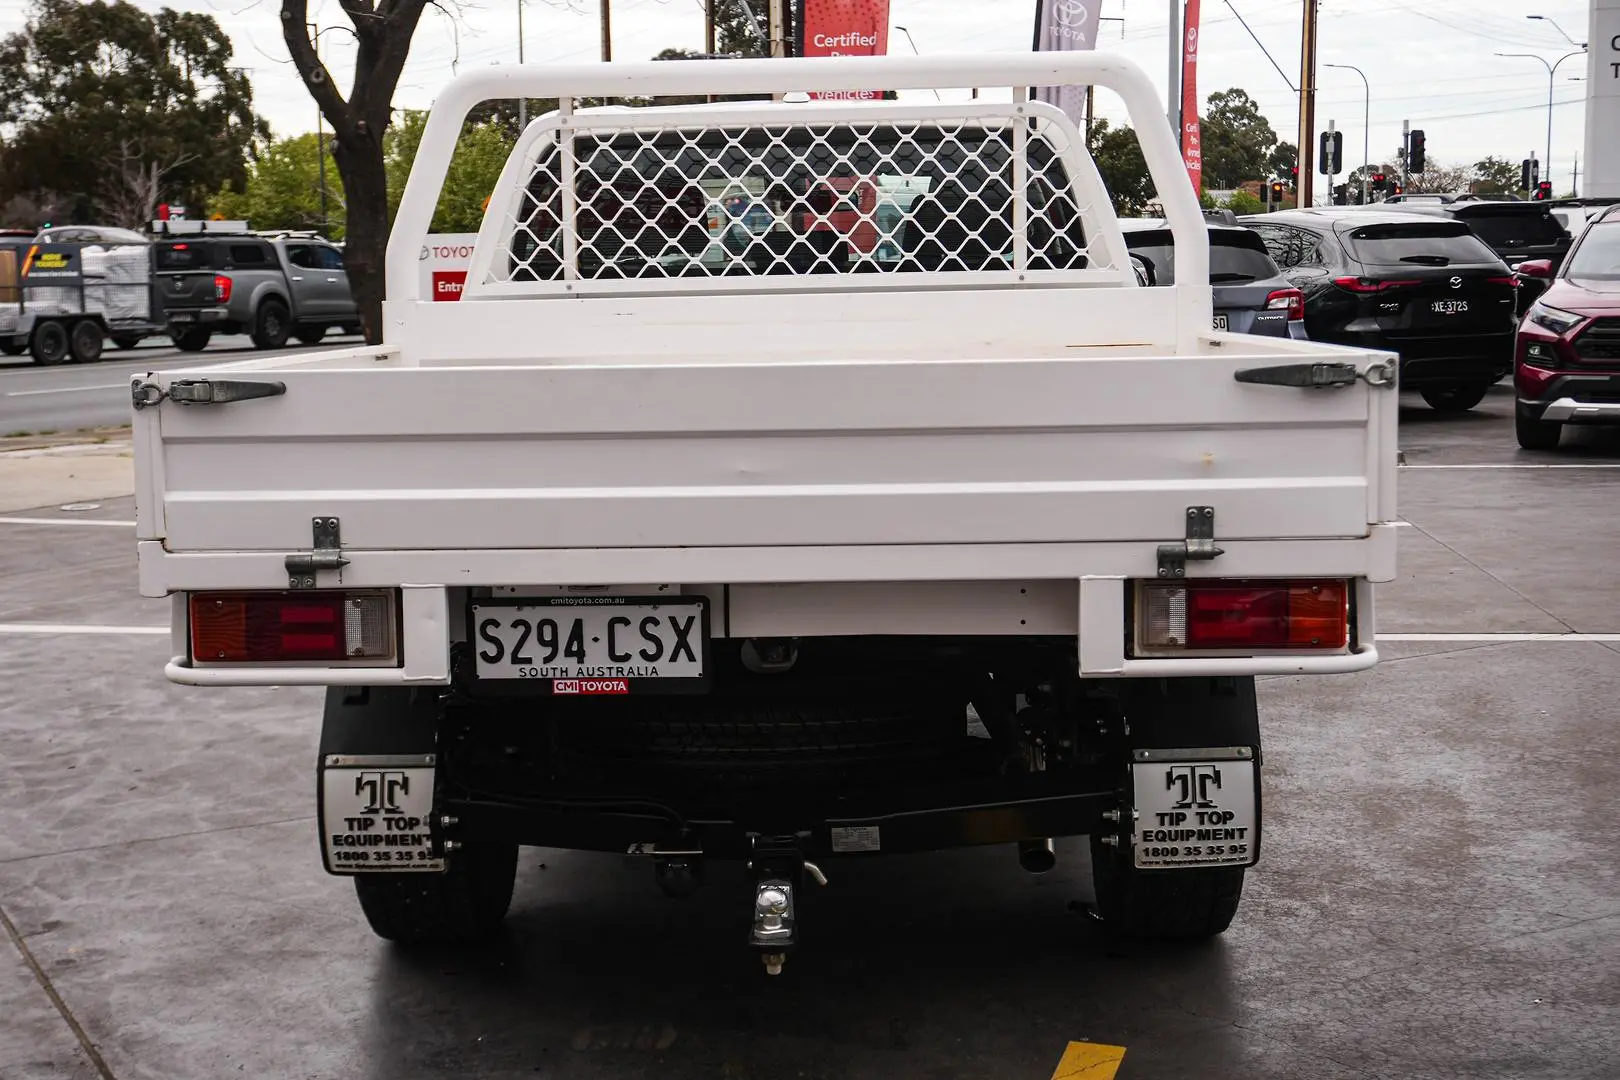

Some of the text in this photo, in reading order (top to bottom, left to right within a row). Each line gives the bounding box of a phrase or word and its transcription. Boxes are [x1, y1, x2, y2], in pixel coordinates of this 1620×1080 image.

[813, 31, 878, 48] Certified
[1049, 26, 1086, 42] TOYOTA
[432, 246, 474, 258] TOYOT
[550, 597, 625, 605] cmitoyota.com.au
[519, 666, 659, 677] SOUTH AUSTRALIA
[555, 681, 627, 692] CMI TOYOTA
[344, 817, 420, 831] TIP TOP
[1155, 810, 1235, 826] TIP TOP
[1142, 827, 1248, 843] EQUIPMENT
[334, 851, 369, 861] 1800
[373, 851, 391, 861] 35
[395, 851, 414, 861] 35
[1142, 844, 1248, 858] 1800 35 35 95
